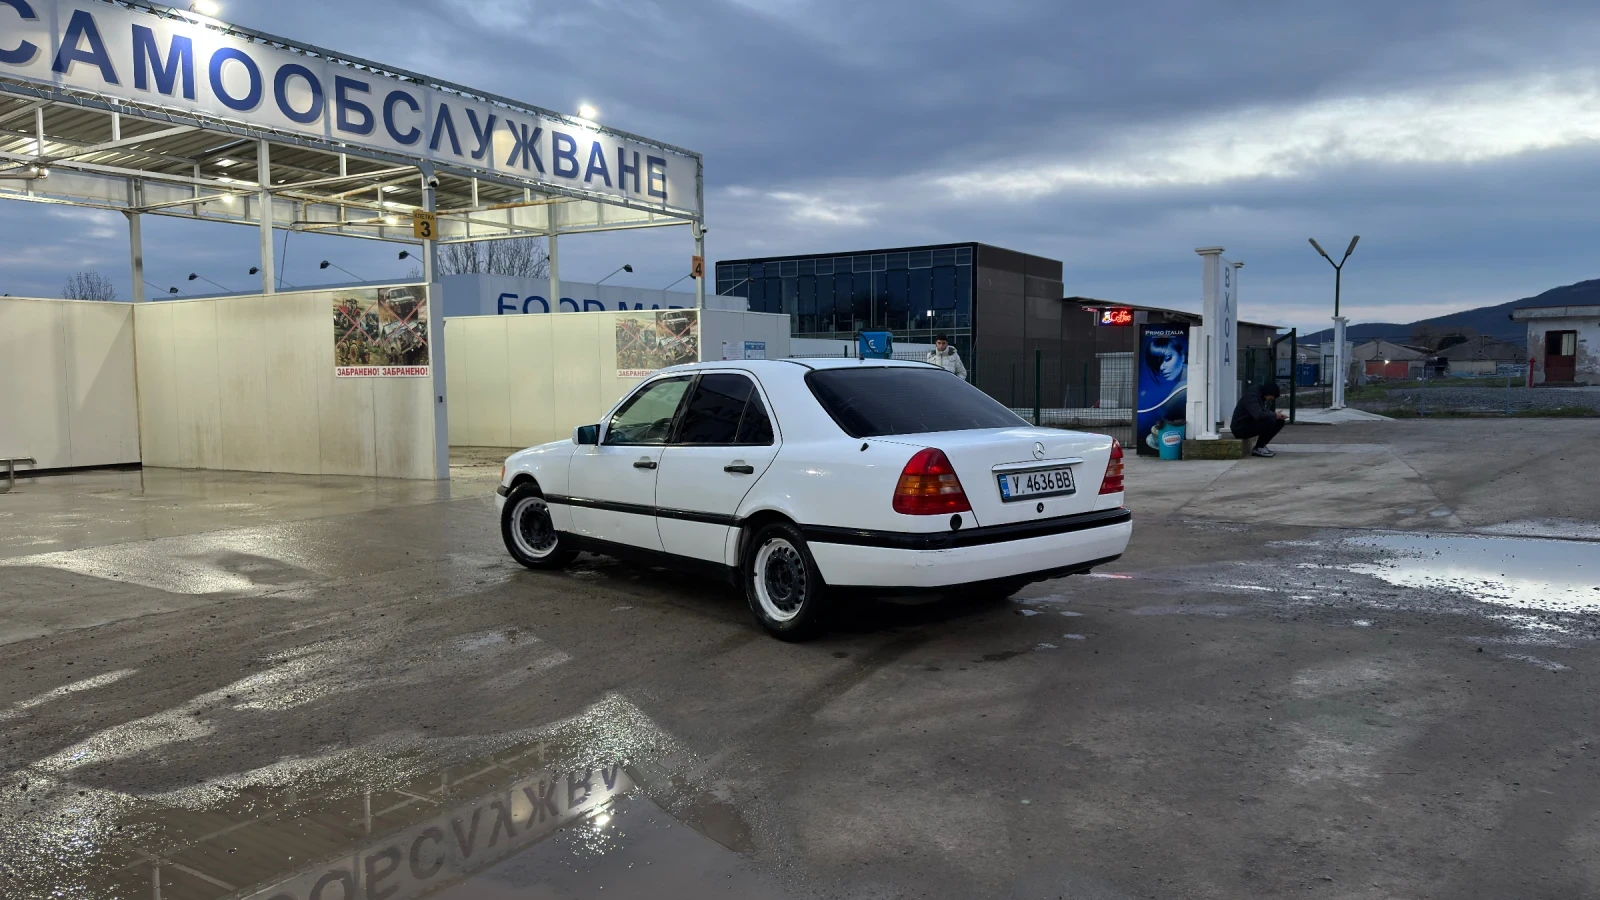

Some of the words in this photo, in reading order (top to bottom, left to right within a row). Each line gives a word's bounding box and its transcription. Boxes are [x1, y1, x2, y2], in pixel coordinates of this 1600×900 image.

[0, 0, 671, 201] САМООБСЛУЖВАНЕ
[420, 221, 431, 237] 3
[695, 262, 702, 276] 4
[1110, 310, 1132, 323] Coffee
[337, 367, 380, 376] ЗАБРАНЕНО!
[382, 367, 428, 376] ЗАБРАНЕНО!
